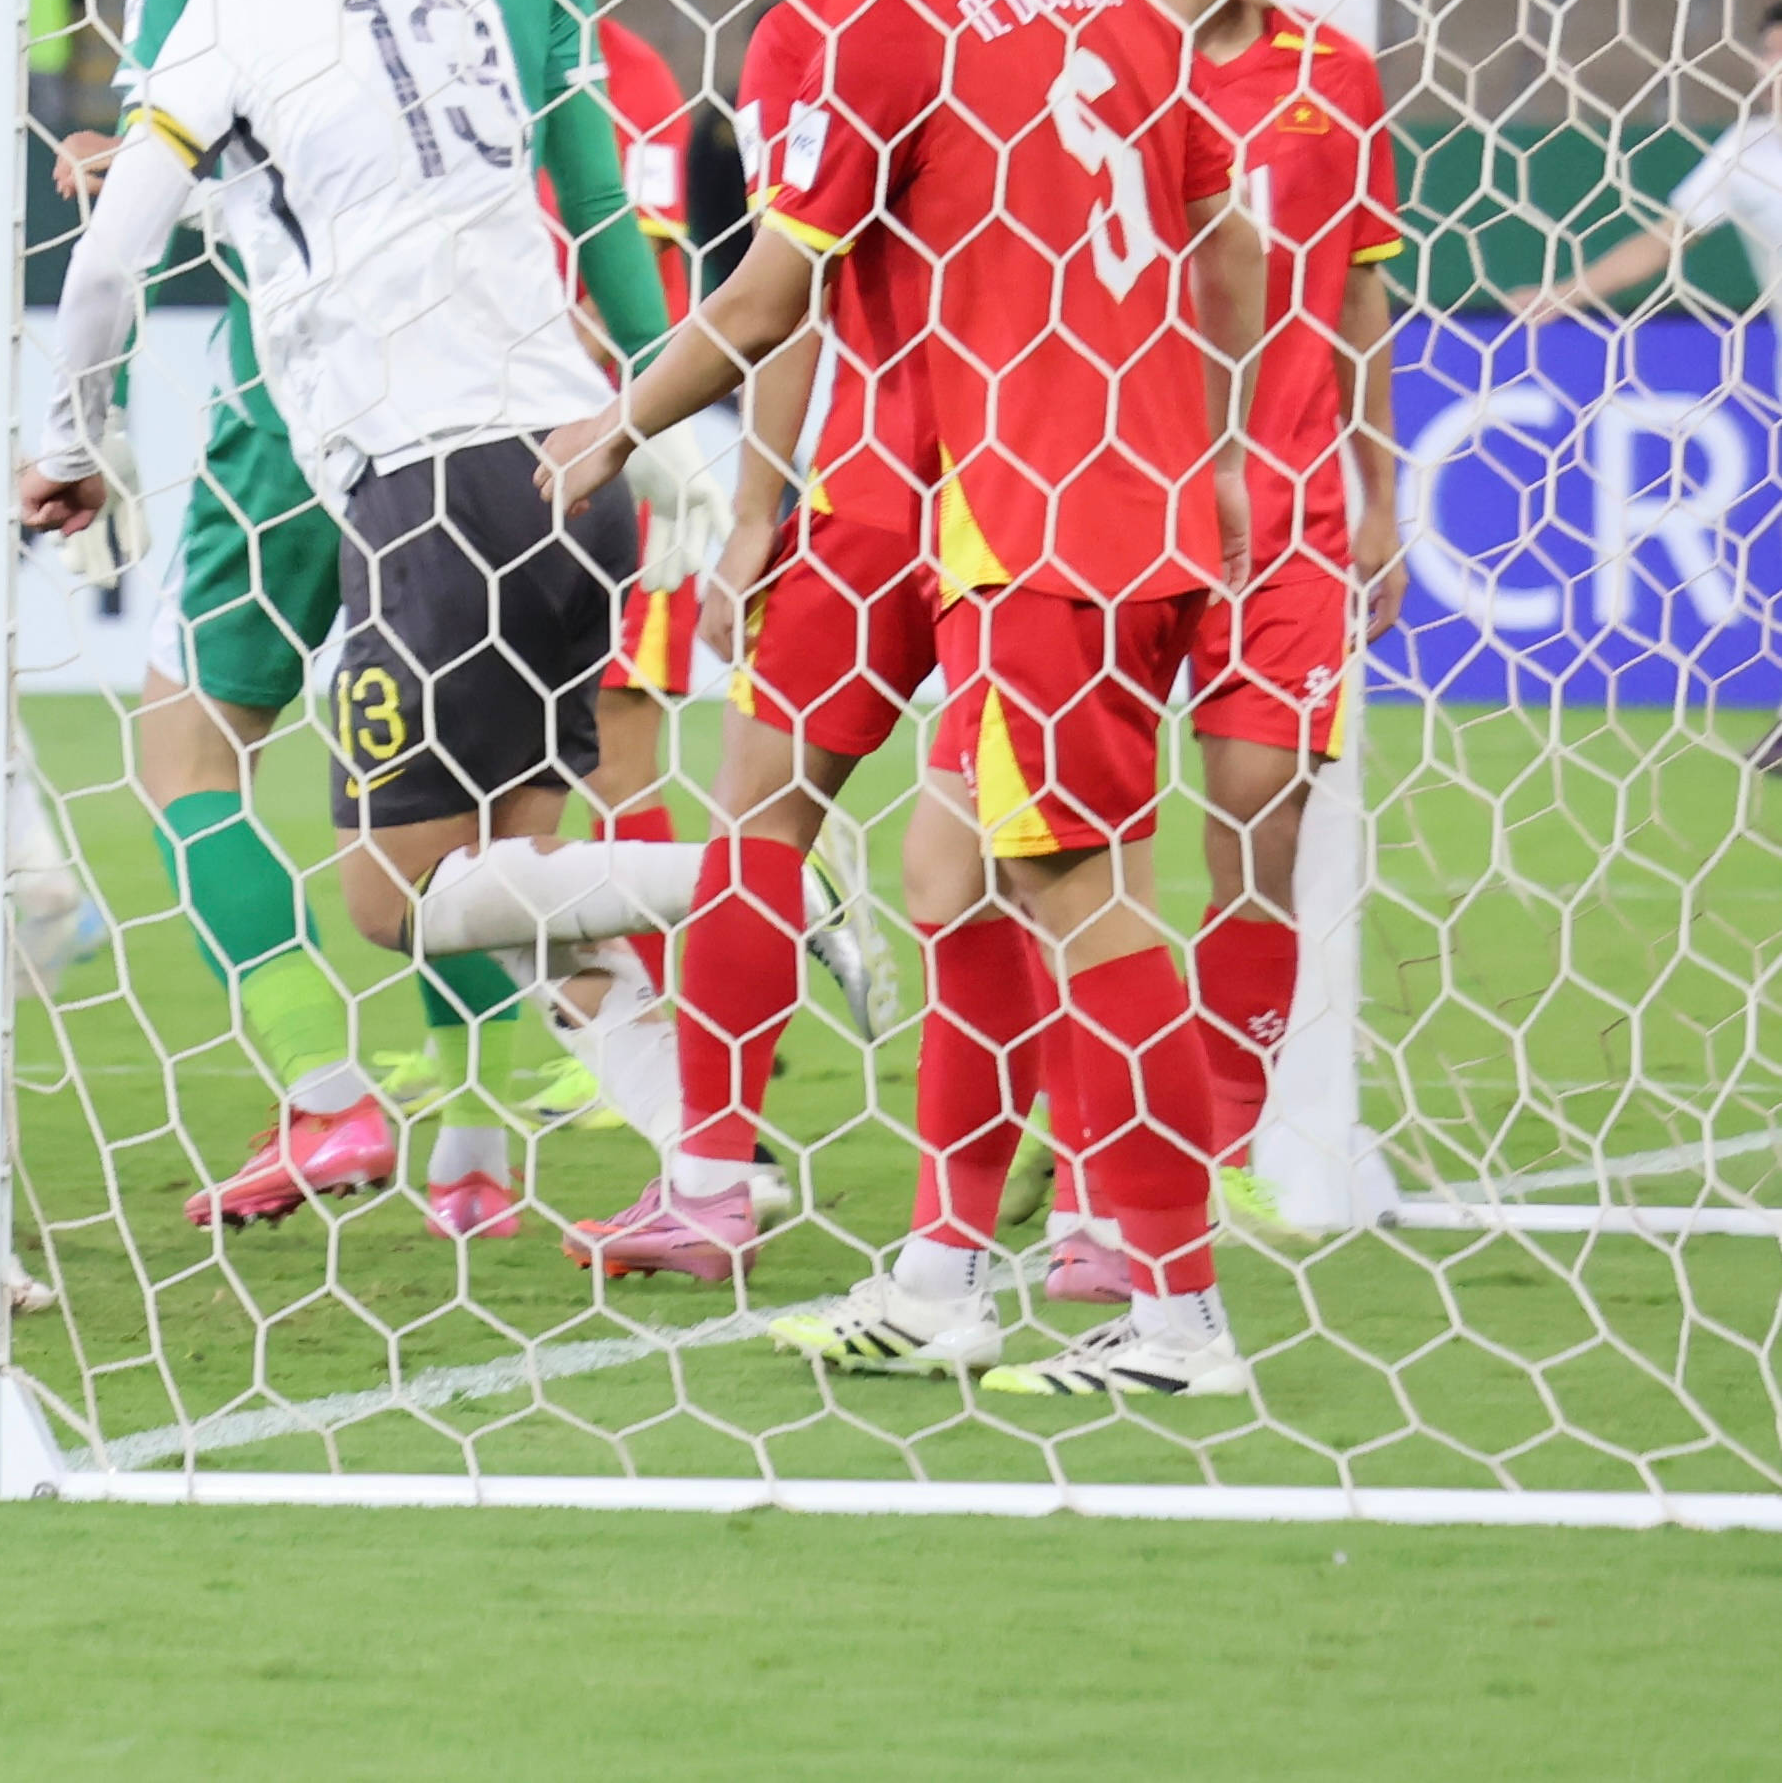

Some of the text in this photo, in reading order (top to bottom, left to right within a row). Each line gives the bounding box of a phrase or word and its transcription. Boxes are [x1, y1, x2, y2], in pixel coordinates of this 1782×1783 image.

[1046, 46, 1157, 305] 5
[1400, 384, 1750, 632] CR
[338, 667, 406, 761] 13
